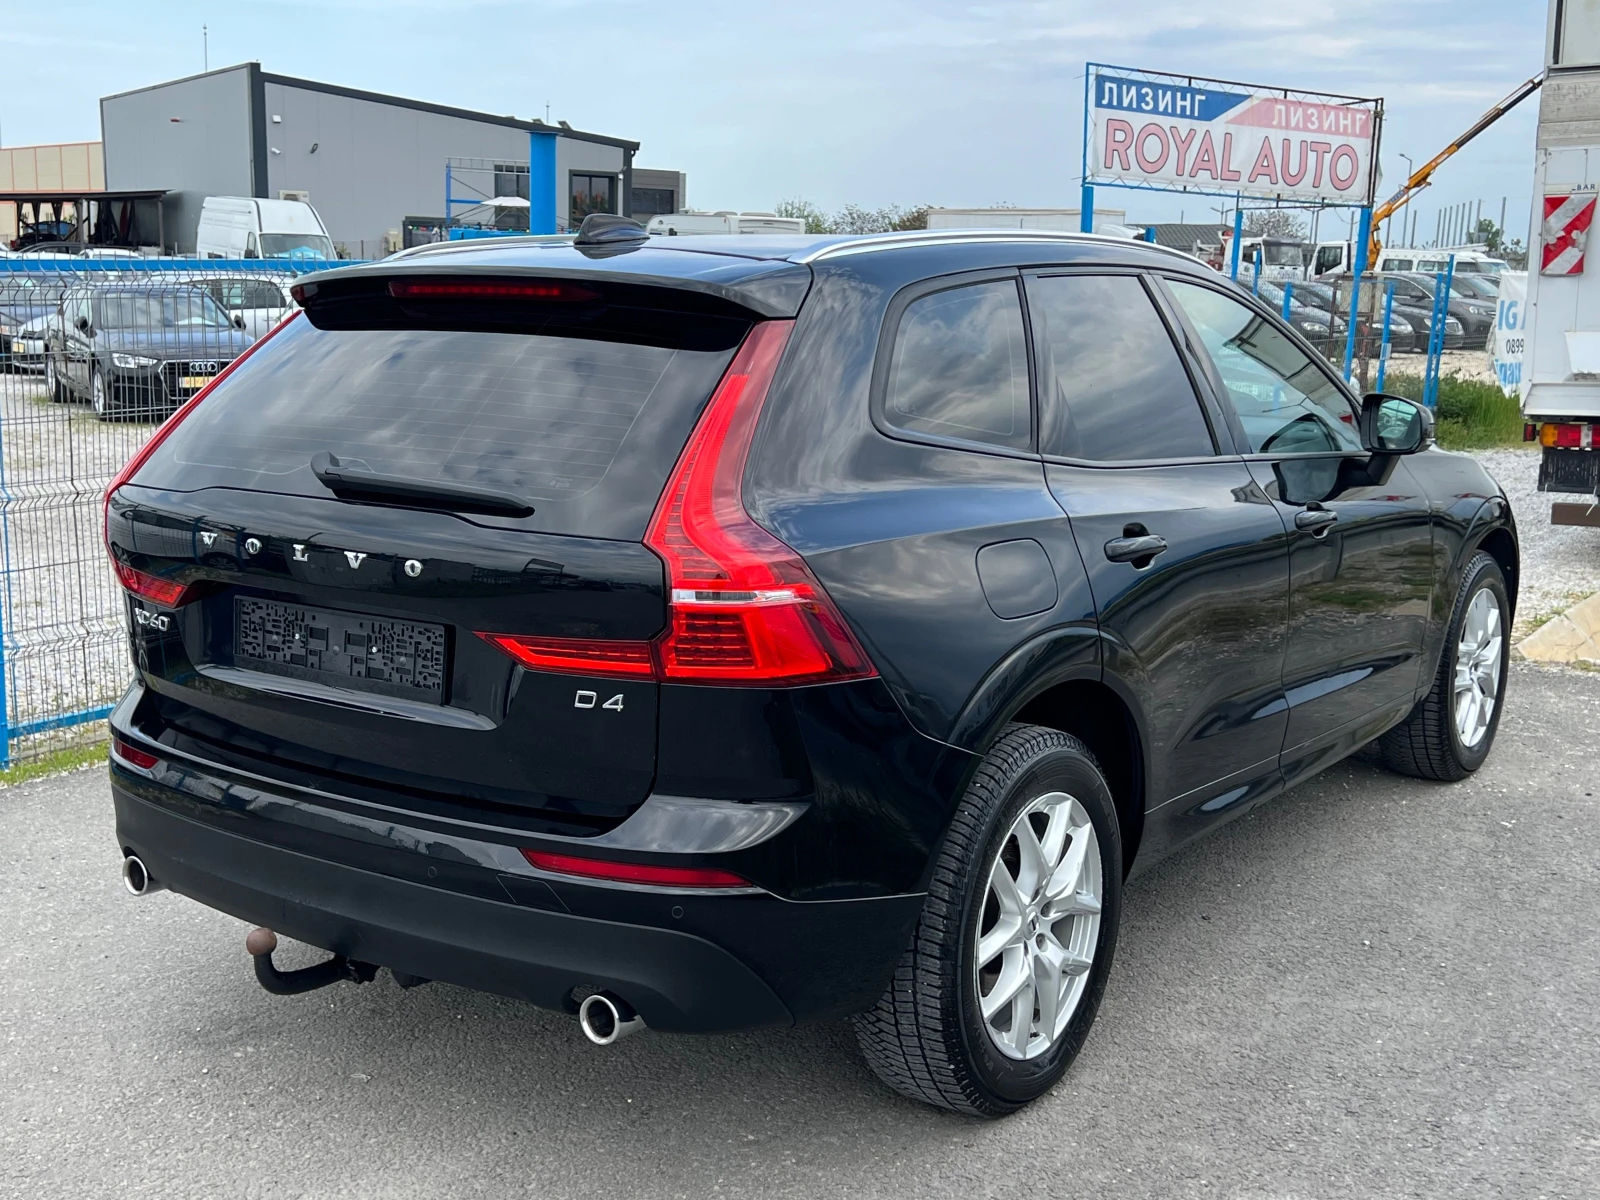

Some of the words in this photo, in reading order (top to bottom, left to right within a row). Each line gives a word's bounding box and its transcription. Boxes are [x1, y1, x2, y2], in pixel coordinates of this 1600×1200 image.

[1101, 81, 1206, 117] ЛИЗИНГ
[1272, 104, 1366, 134] ЛИЗИНГ
[1104, 118, 1241, 182] ROYAL
[1247, 135, 1359, 191] AUTO
[1505, 338, 1524, 354] 0899
[200, 531, 424, 578] VOLVO
[134, 607, 170, 632] XC60
